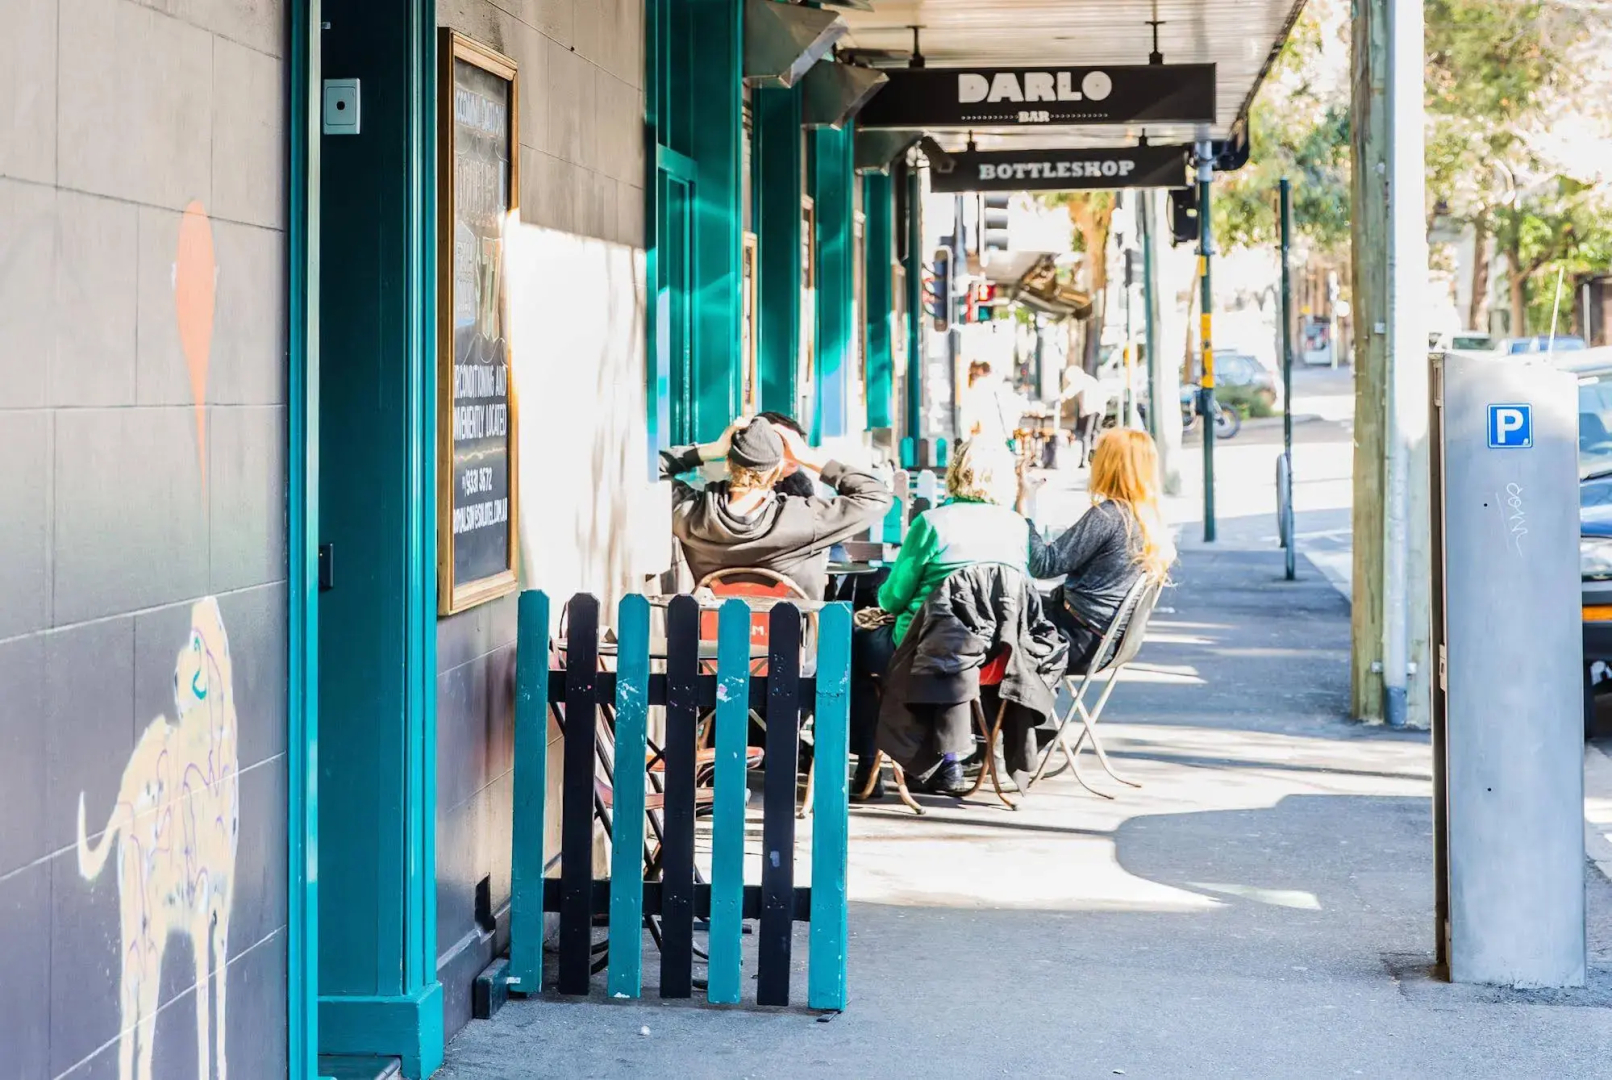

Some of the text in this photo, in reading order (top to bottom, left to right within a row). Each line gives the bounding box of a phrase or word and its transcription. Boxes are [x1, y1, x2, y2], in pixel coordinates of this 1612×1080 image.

[958, 71, 1112, 103] DARLO
[1018, 111, 1050, 122] BAR
[979, 160, 1135, 180] BOTTLESHOP
[495, 364, 507, 397] AND
[486, 403, 507, 437] LOCATED
[1496, 409, 1524, 443] P
